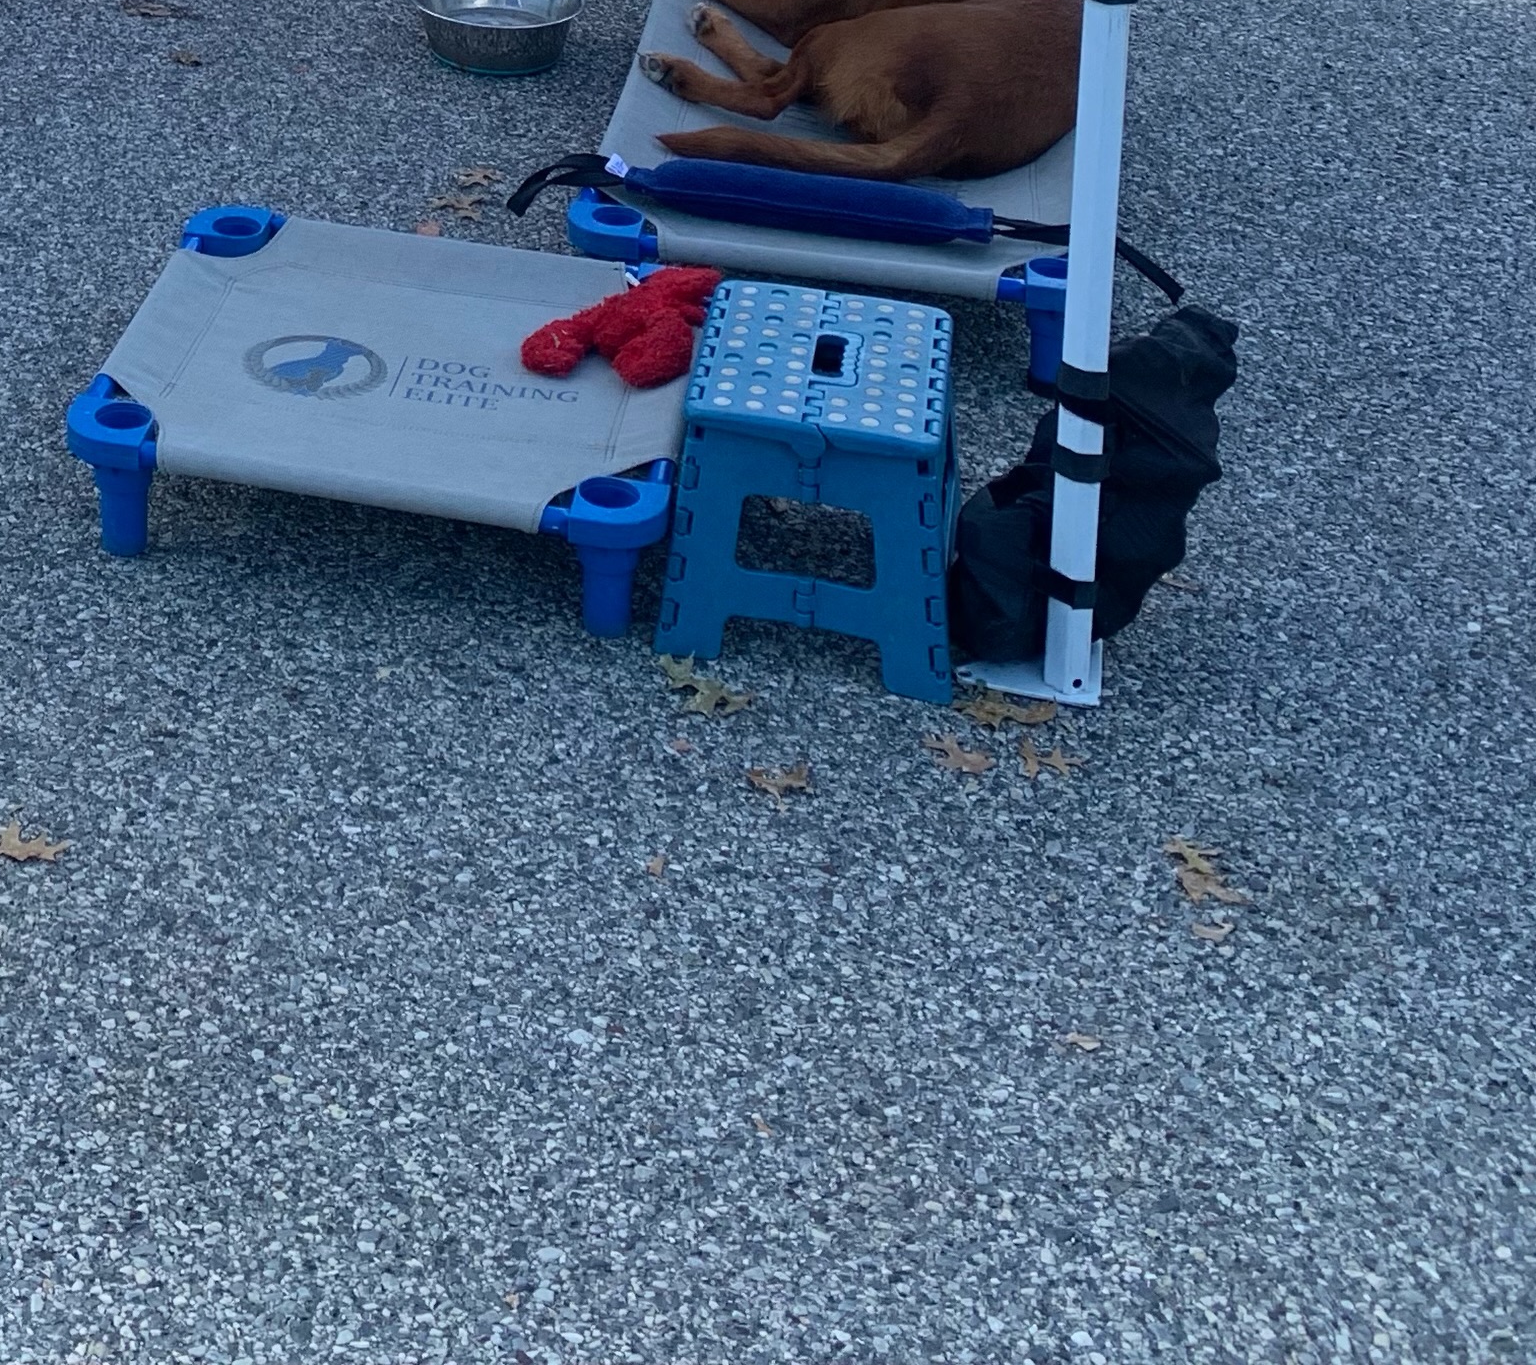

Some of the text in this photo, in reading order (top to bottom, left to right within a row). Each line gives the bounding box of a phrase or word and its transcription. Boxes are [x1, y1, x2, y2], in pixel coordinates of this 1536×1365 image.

[417, 357, 491, 378] DOG
[404, 386, 499, 411] ELITE
[411, 372, 580, 403] TRAINING
